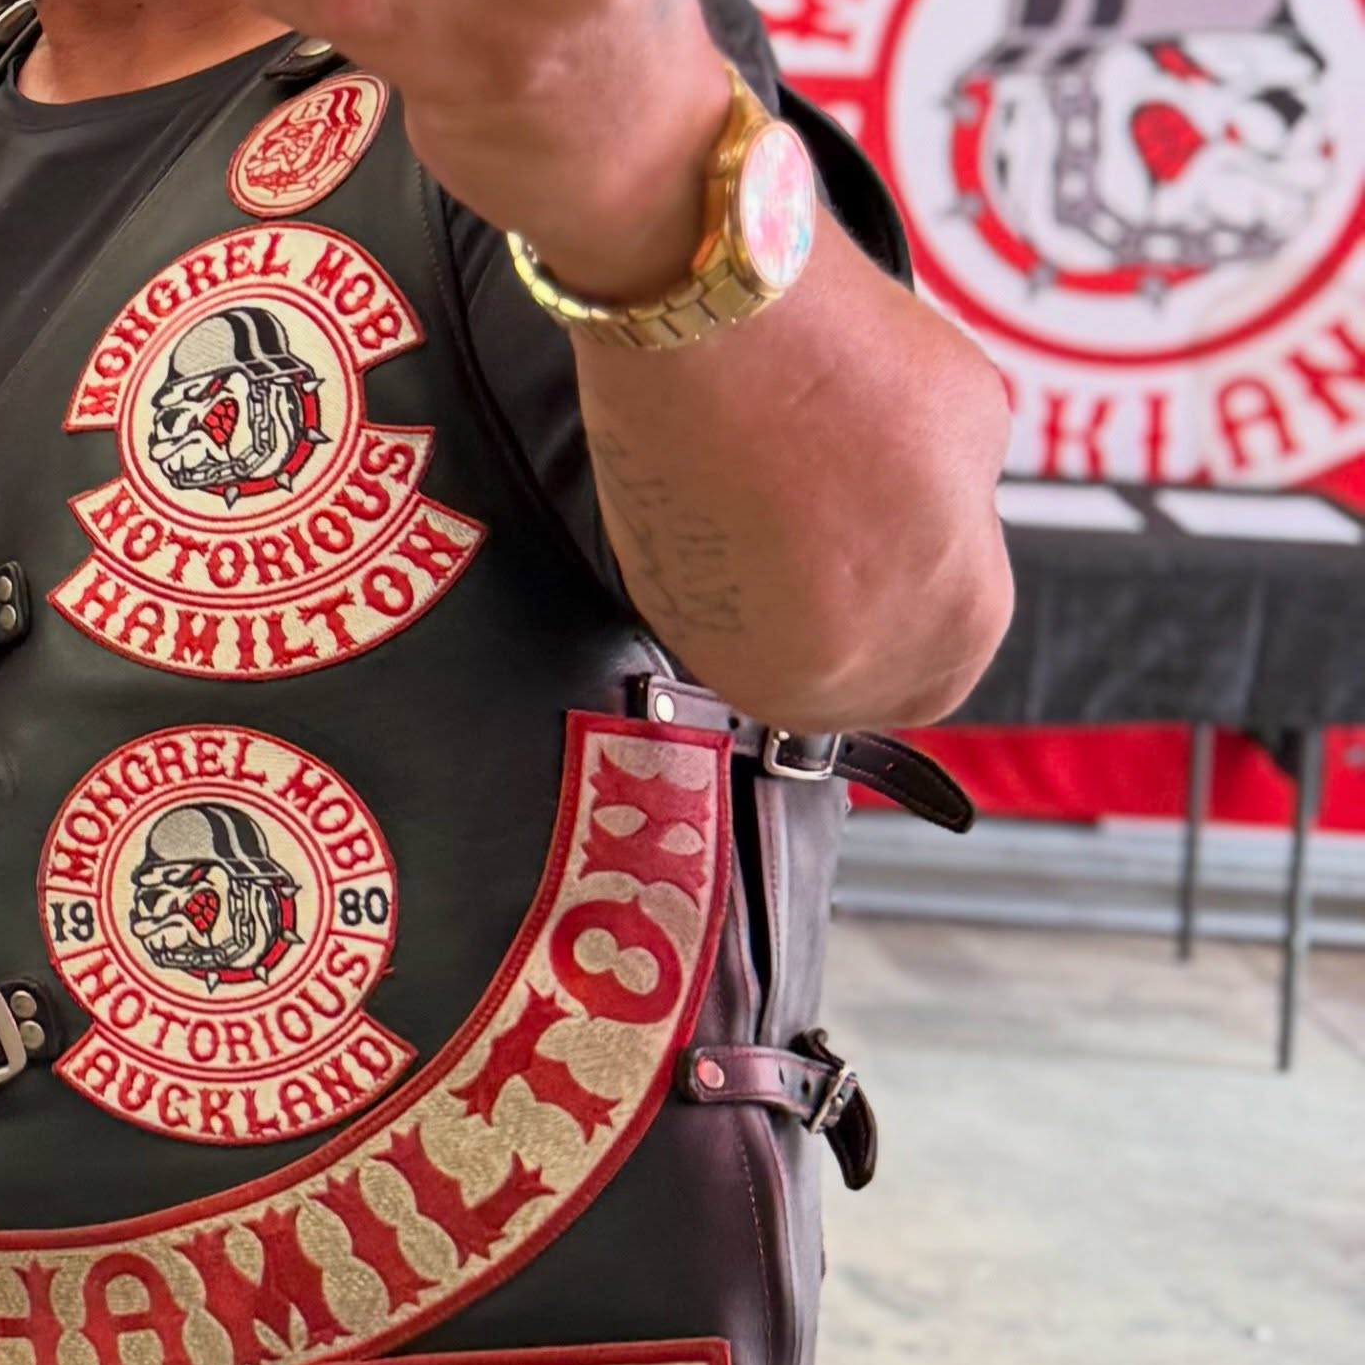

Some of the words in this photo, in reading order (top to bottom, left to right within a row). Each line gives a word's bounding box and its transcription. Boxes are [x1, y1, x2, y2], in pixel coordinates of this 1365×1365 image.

[77, 229, 291, 417] MONGREL
[304, 252, 403, 352] MOB
[1001, 321, 1365, 485] KLAN
[90, 436, 417, 588] NOTORIOUS
[71, 513, 469, 671] HAMILTON
[49, 730, 268, 885] MONGREL
[273, 761, 377, 873] MOB
[51, 901, 96, 942] 19
[338, 886, 389, 926] 80
[70, 941, 371, 1064] NOTORIOUS
[74, 1033, 395, 1136] AUCKLAND
